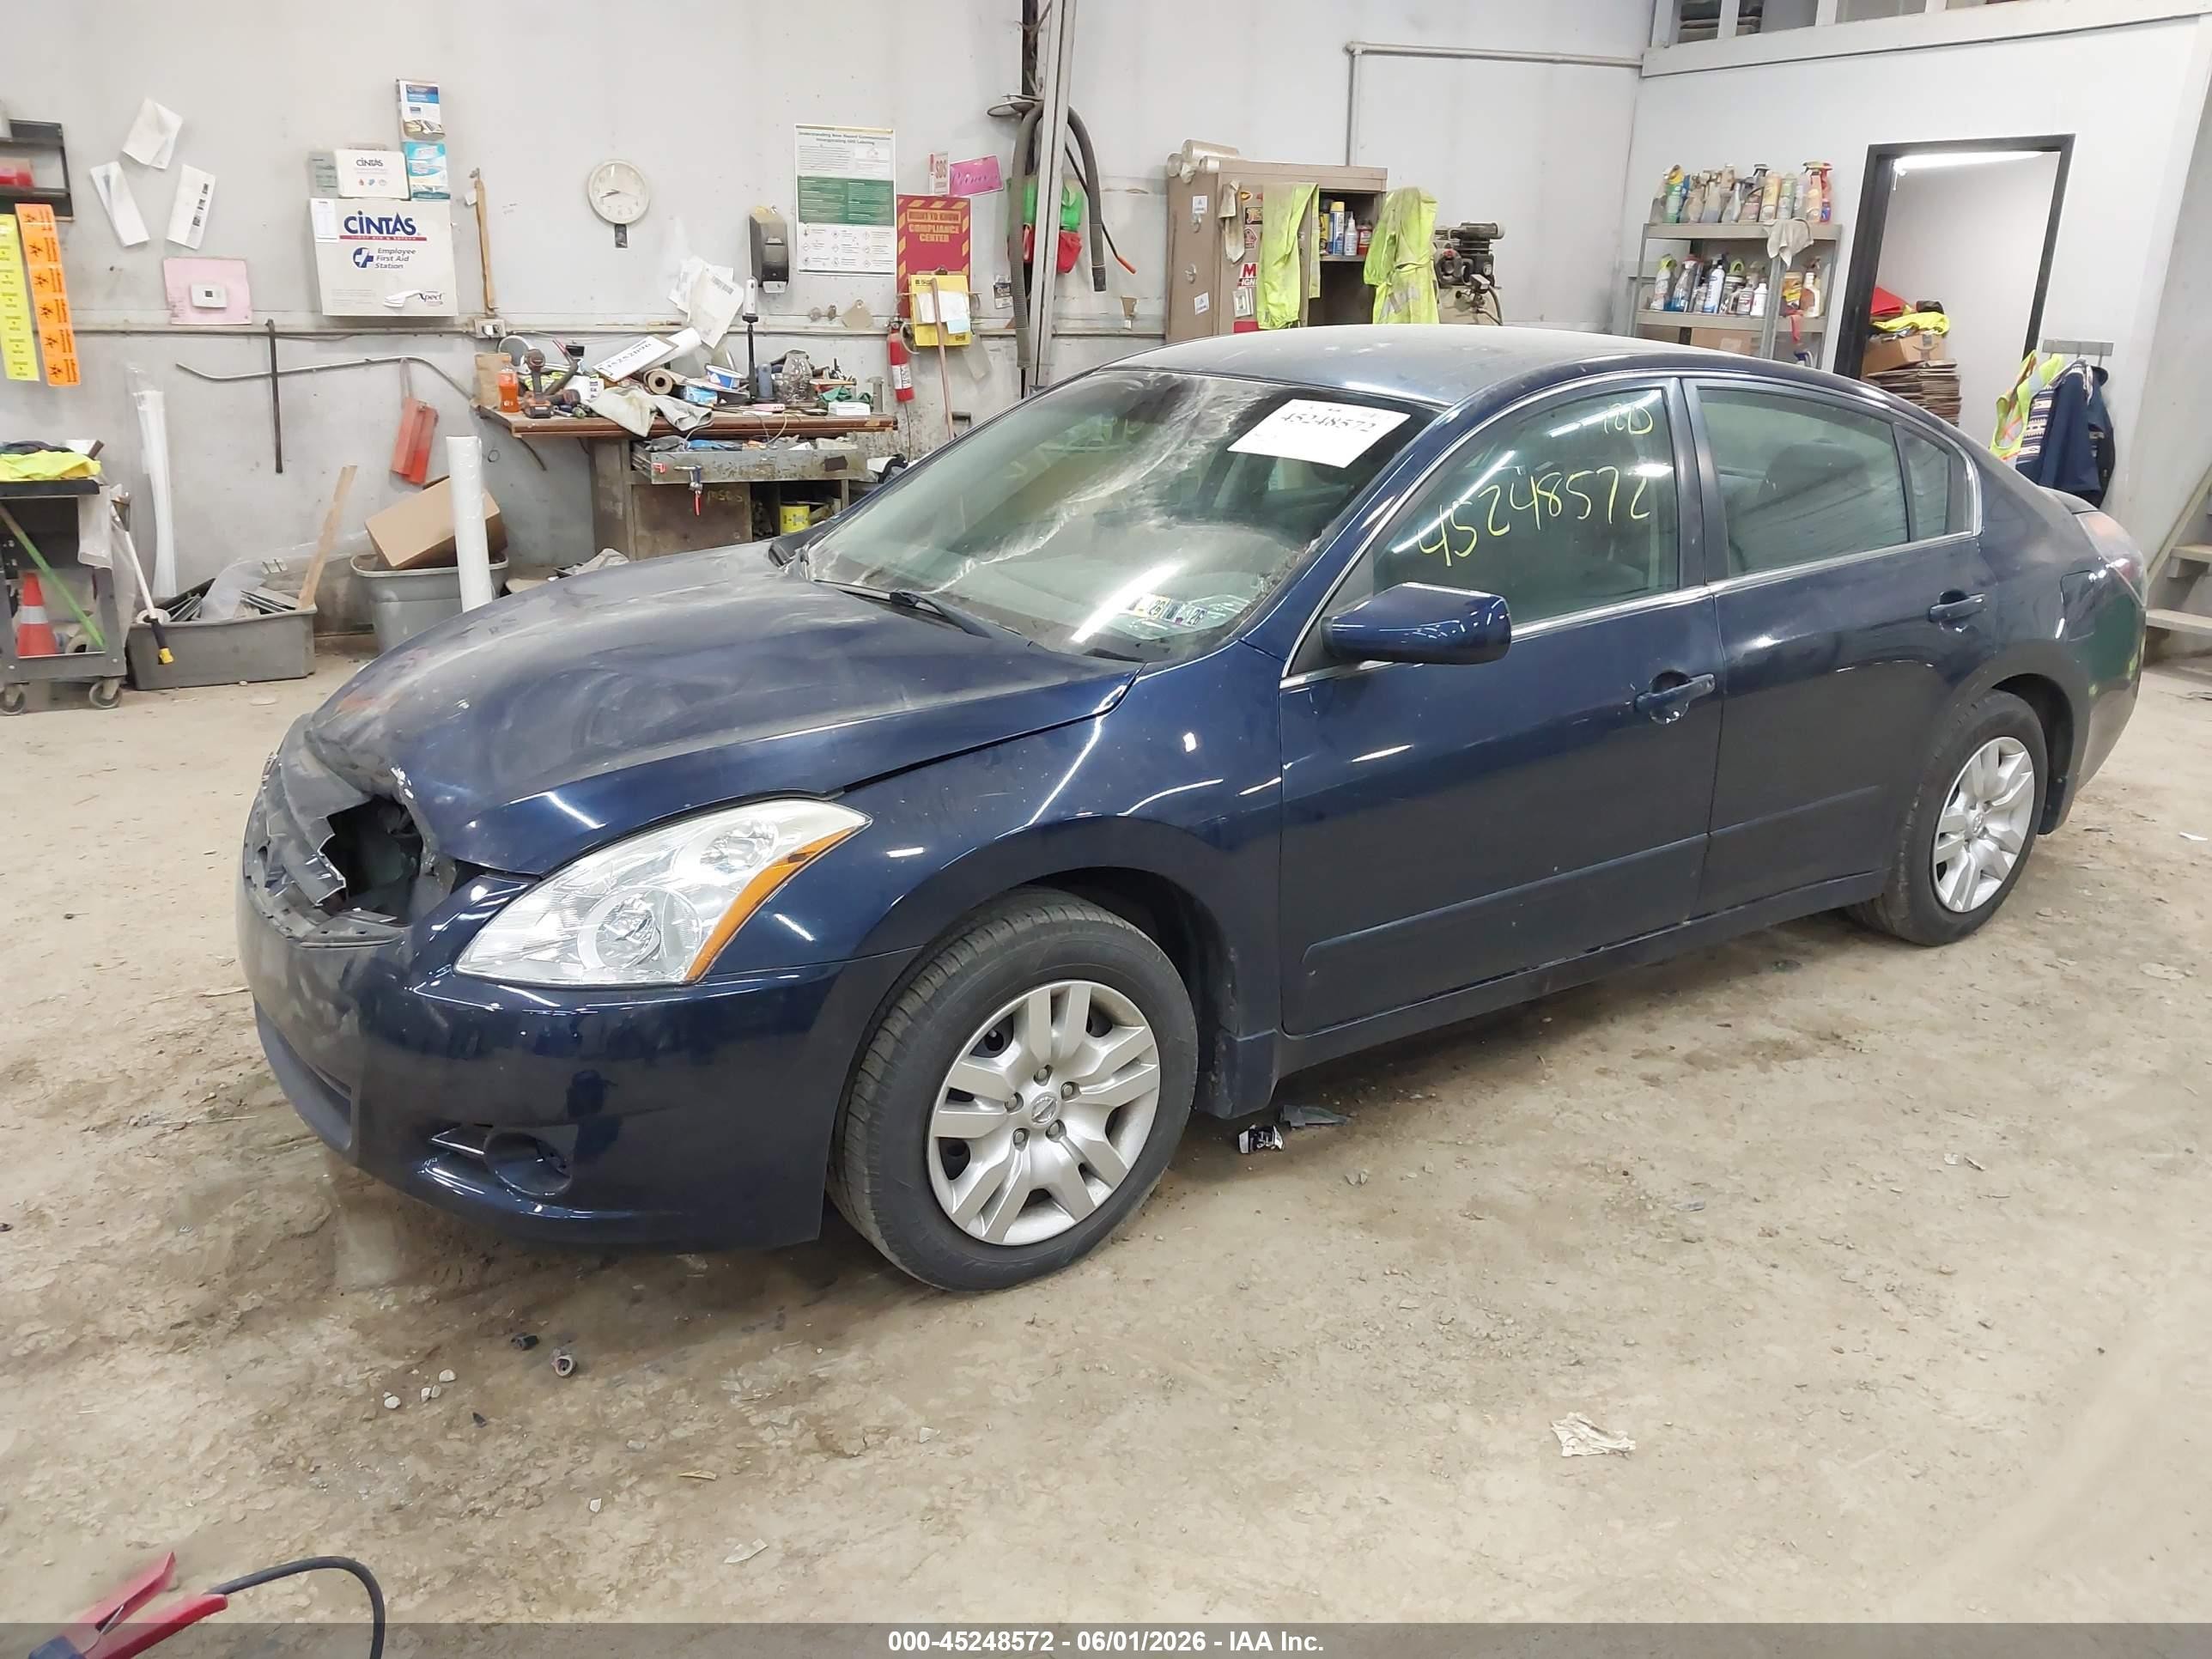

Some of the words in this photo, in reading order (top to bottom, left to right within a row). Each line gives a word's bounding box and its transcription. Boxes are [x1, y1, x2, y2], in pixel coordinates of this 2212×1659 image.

[356, 157, 384, 167] CINTAS
[939, 212, 959, 221] KNOW
[343, 210, 416, 235] CINTAS
[908, 224, 959, 234] COMPLIANCE
[920, 234, 950, 242] CENTER
[378, 247, 416, 256] Employee
[1281, 413, 1376, 432] 45248572
[1418, 465, 1650, 567] 45248572
